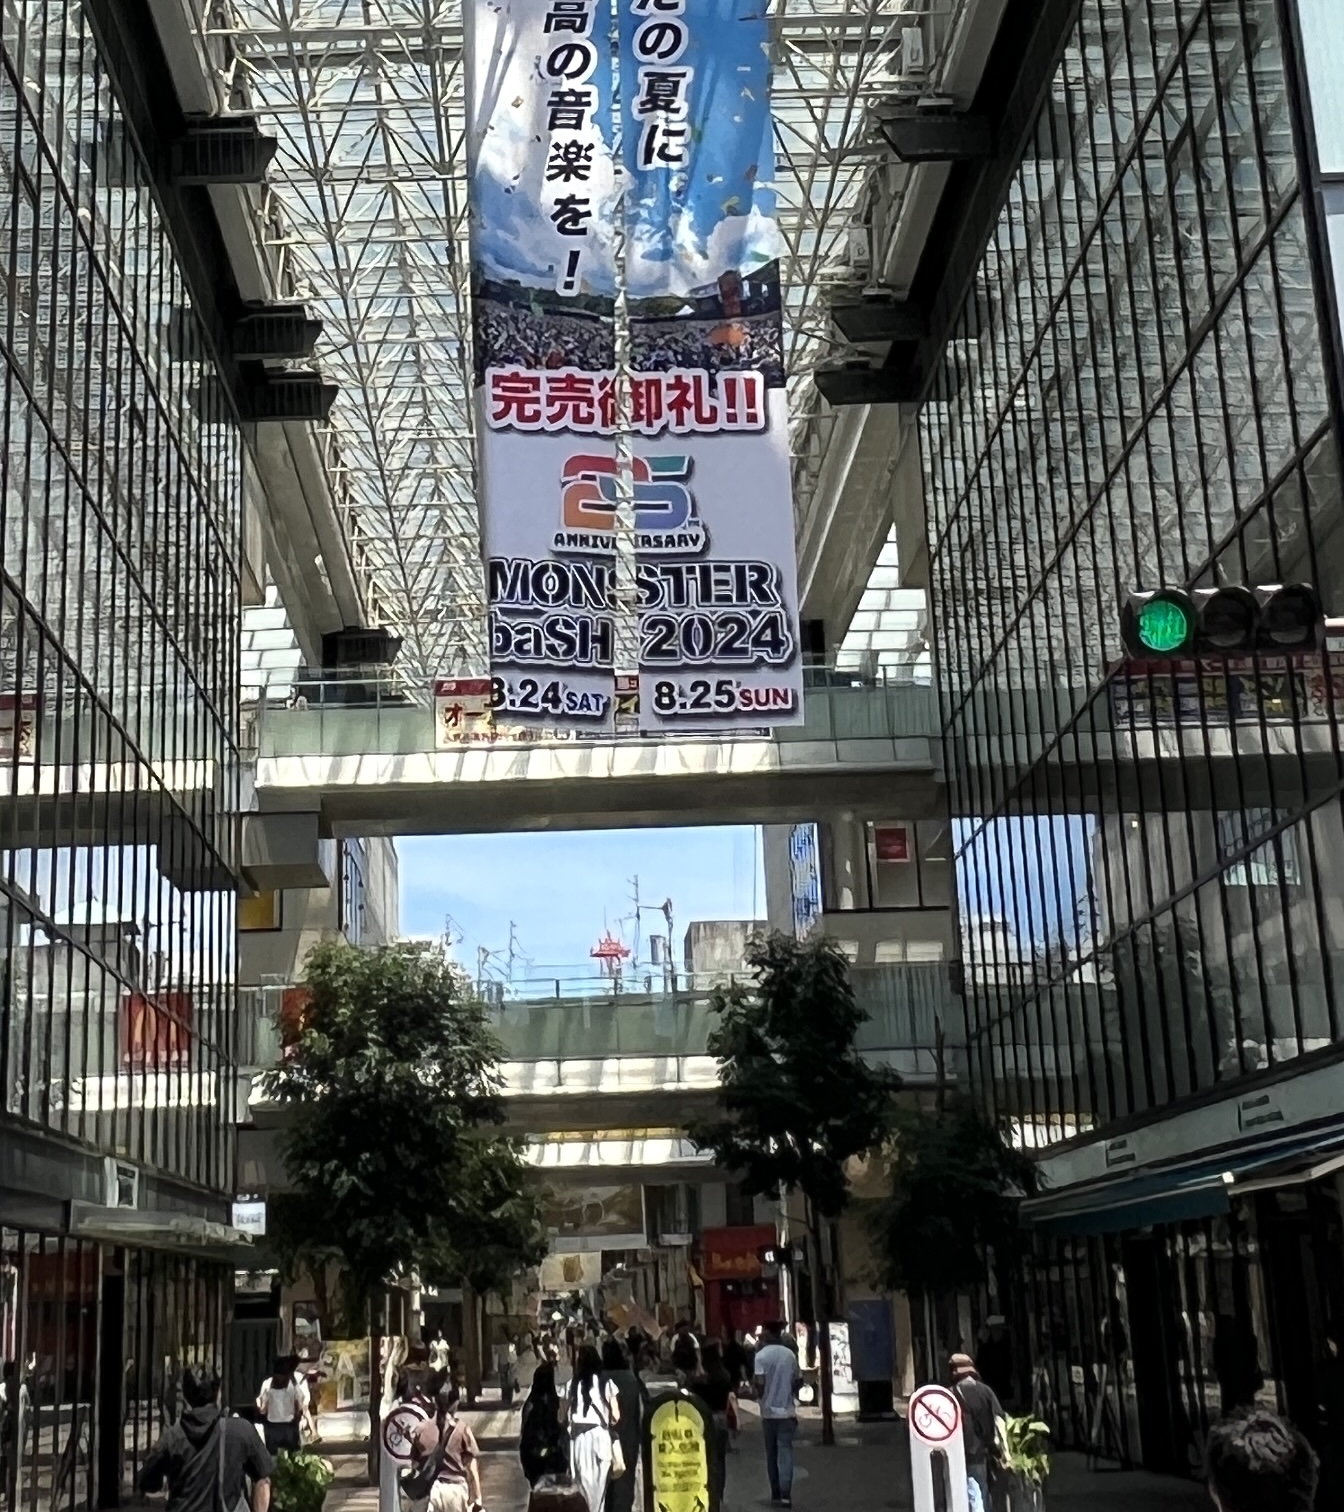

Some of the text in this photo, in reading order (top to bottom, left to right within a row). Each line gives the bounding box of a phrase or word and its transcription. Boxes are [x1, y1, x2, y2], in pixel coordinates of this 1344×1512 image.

[561, 454, 690, 530] 25
[490, 560, 779, 608] MONSTER
[642, 612, 792, 662] 2024
[565, 691, 607, 713] SAT
[656, 680, 792, 710] 8.25 SUN
